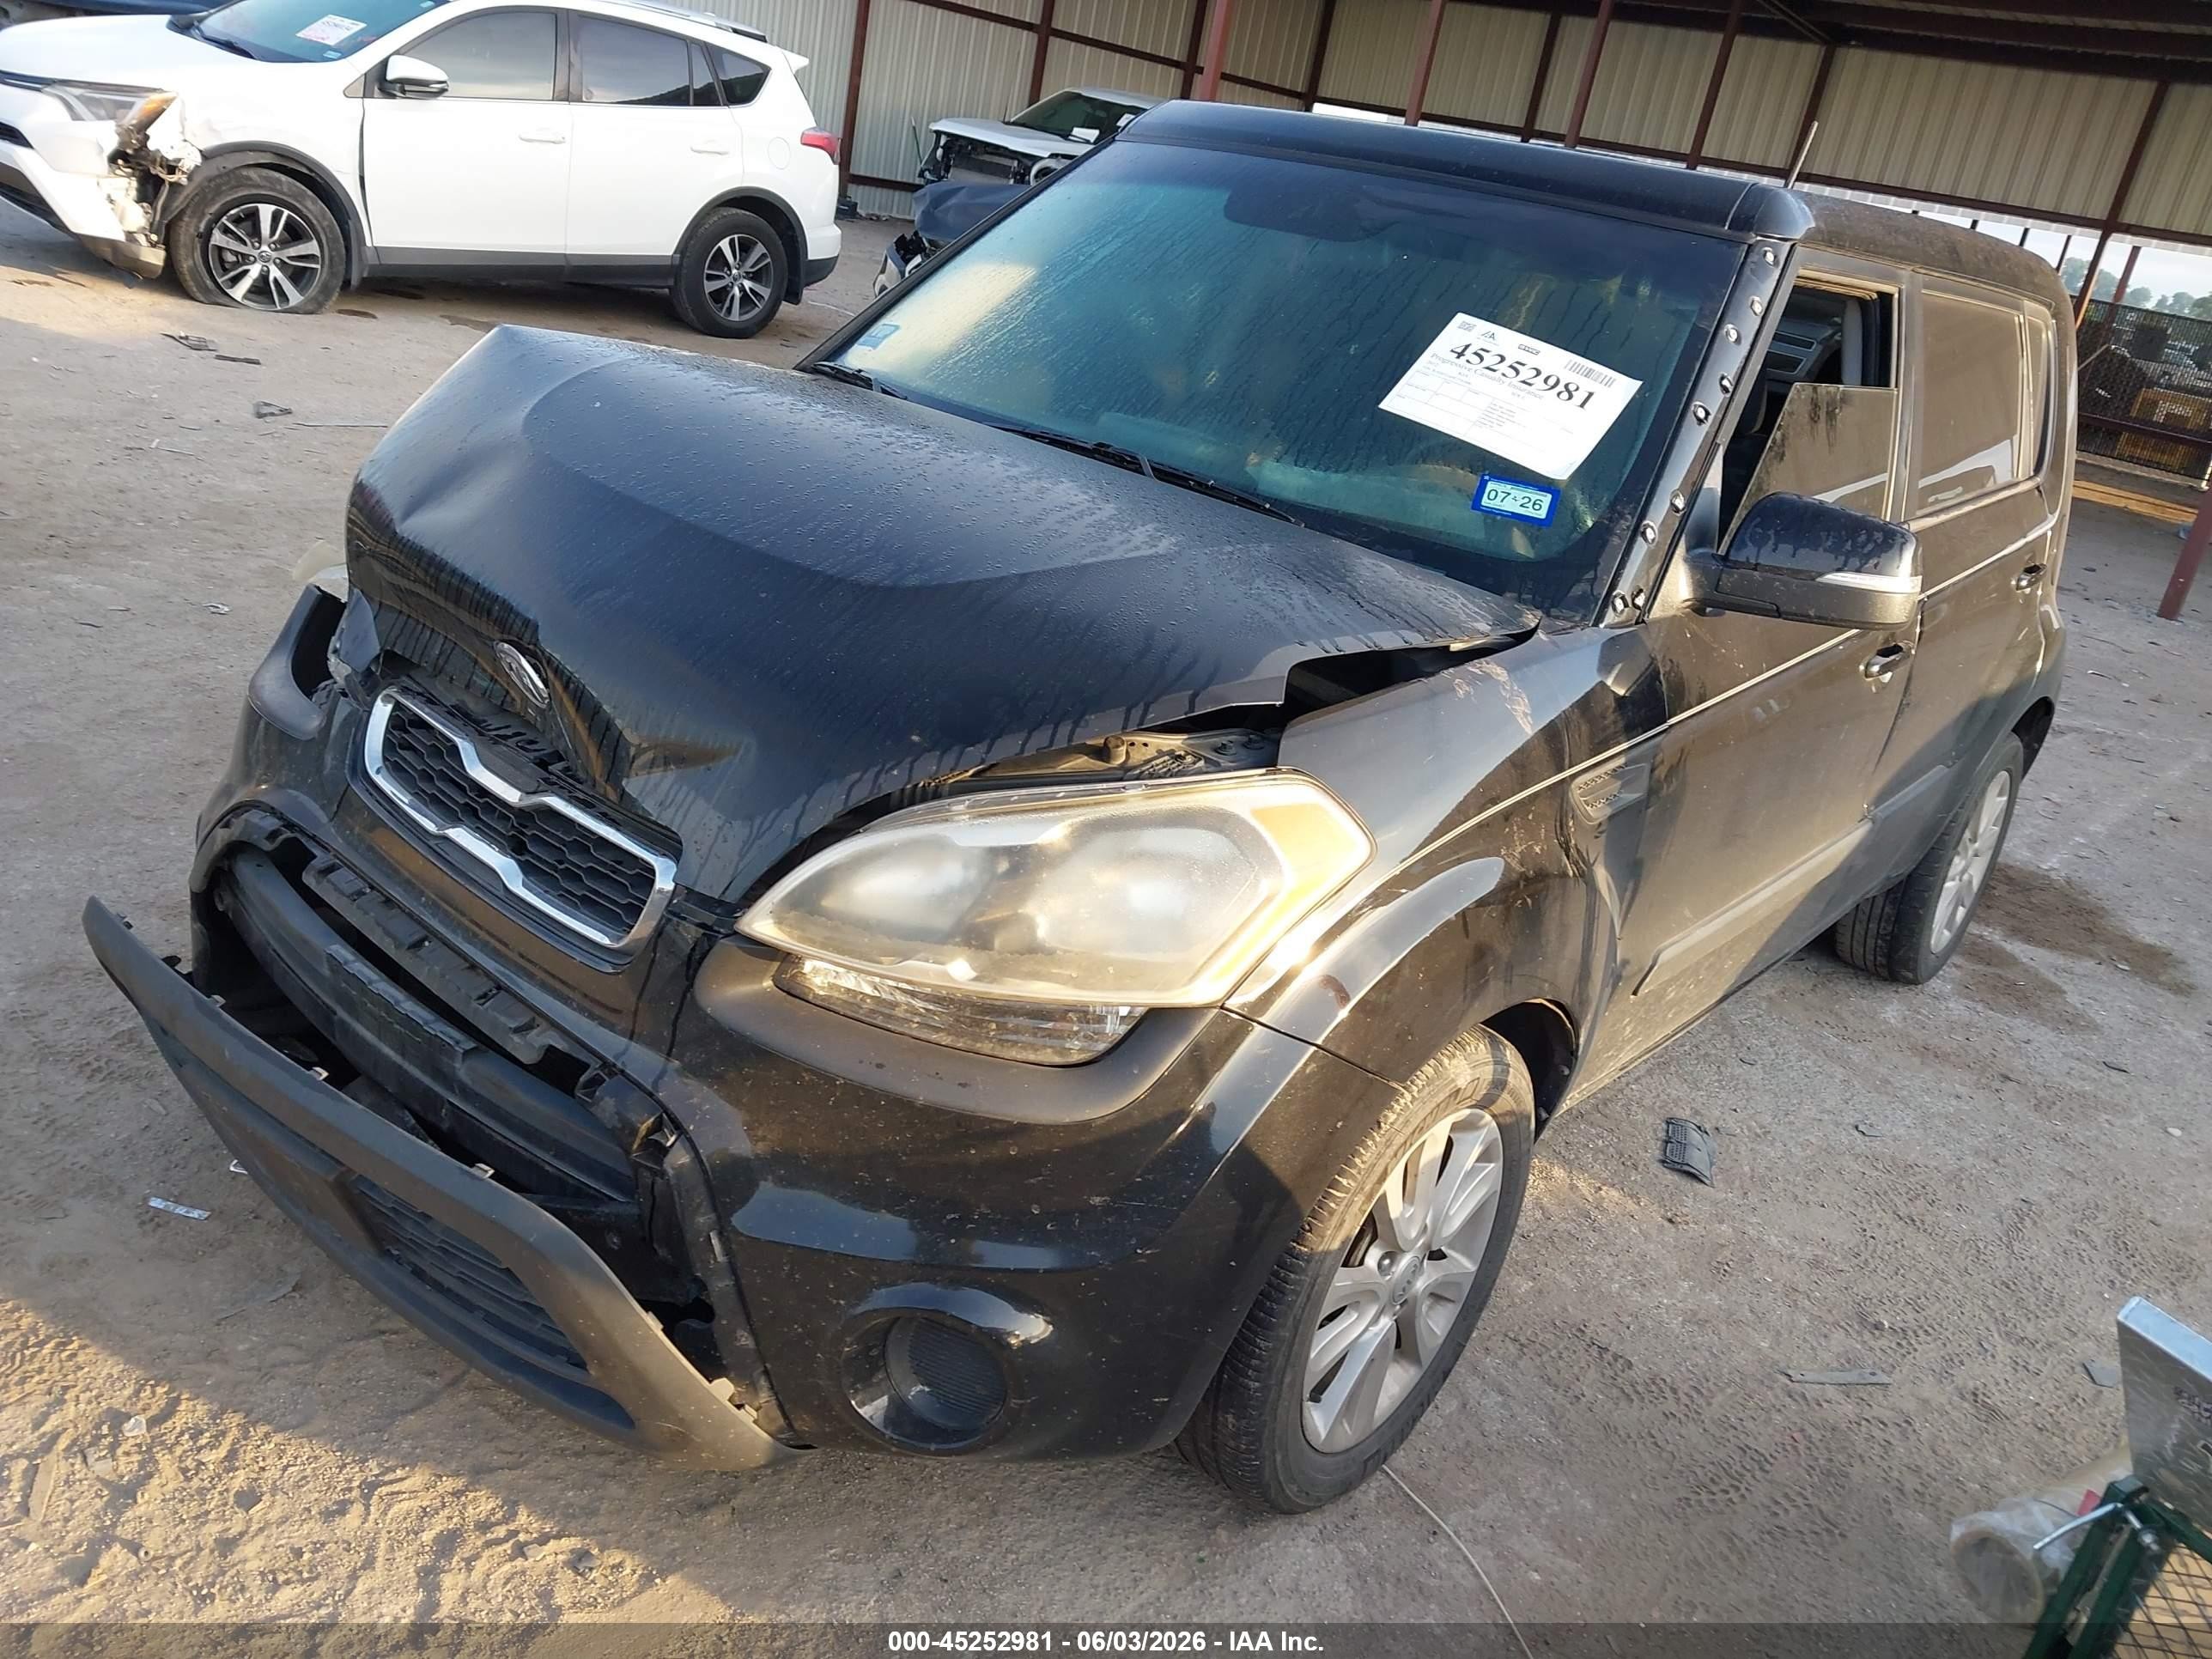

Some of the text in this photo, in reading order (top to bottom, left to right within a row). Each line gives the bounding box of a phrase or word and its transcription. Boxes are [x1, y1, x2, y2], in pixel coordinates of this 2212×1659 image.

[1431, 353, 1473, 372] Progressive
[1508, 382, 1545, 399] Insurance
[1449, 343, 1595, 410] 45252981
